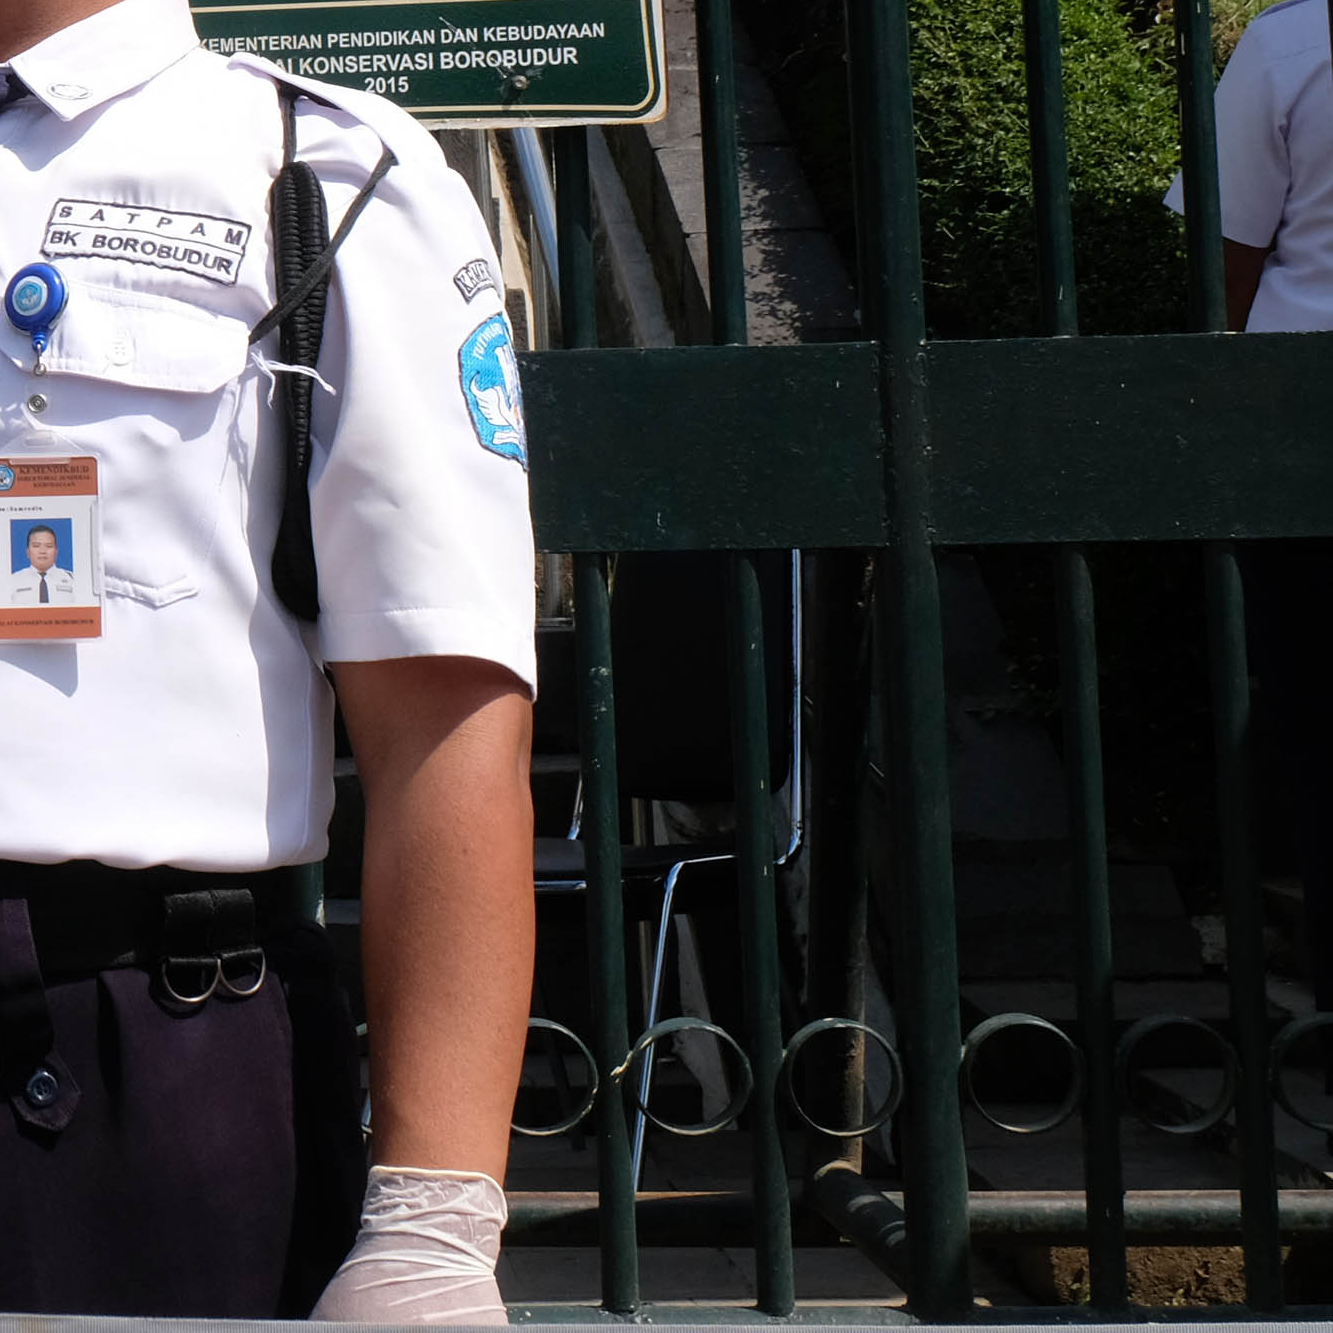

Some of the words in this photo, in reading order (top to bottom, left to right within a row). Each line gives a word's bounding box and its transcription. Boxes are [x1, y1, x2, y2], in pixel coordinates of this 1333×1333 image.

[200, 34, 322, 53] KEMENTERIAN
[327, 29, 434, 48] PENDIDIKAN
[440, 27, 478, 45] DAN
[482, 22, 606, 43] KEBUDAYAAN
[299, 52, 434, 75] KONSERVASI
[440, 47, 578, 69] BOROBUDUR
[363, 77, 409, 94] 2015
[49, 230, 78, 247] BK
[91, 234, 233, 275] BOROBUDUR
